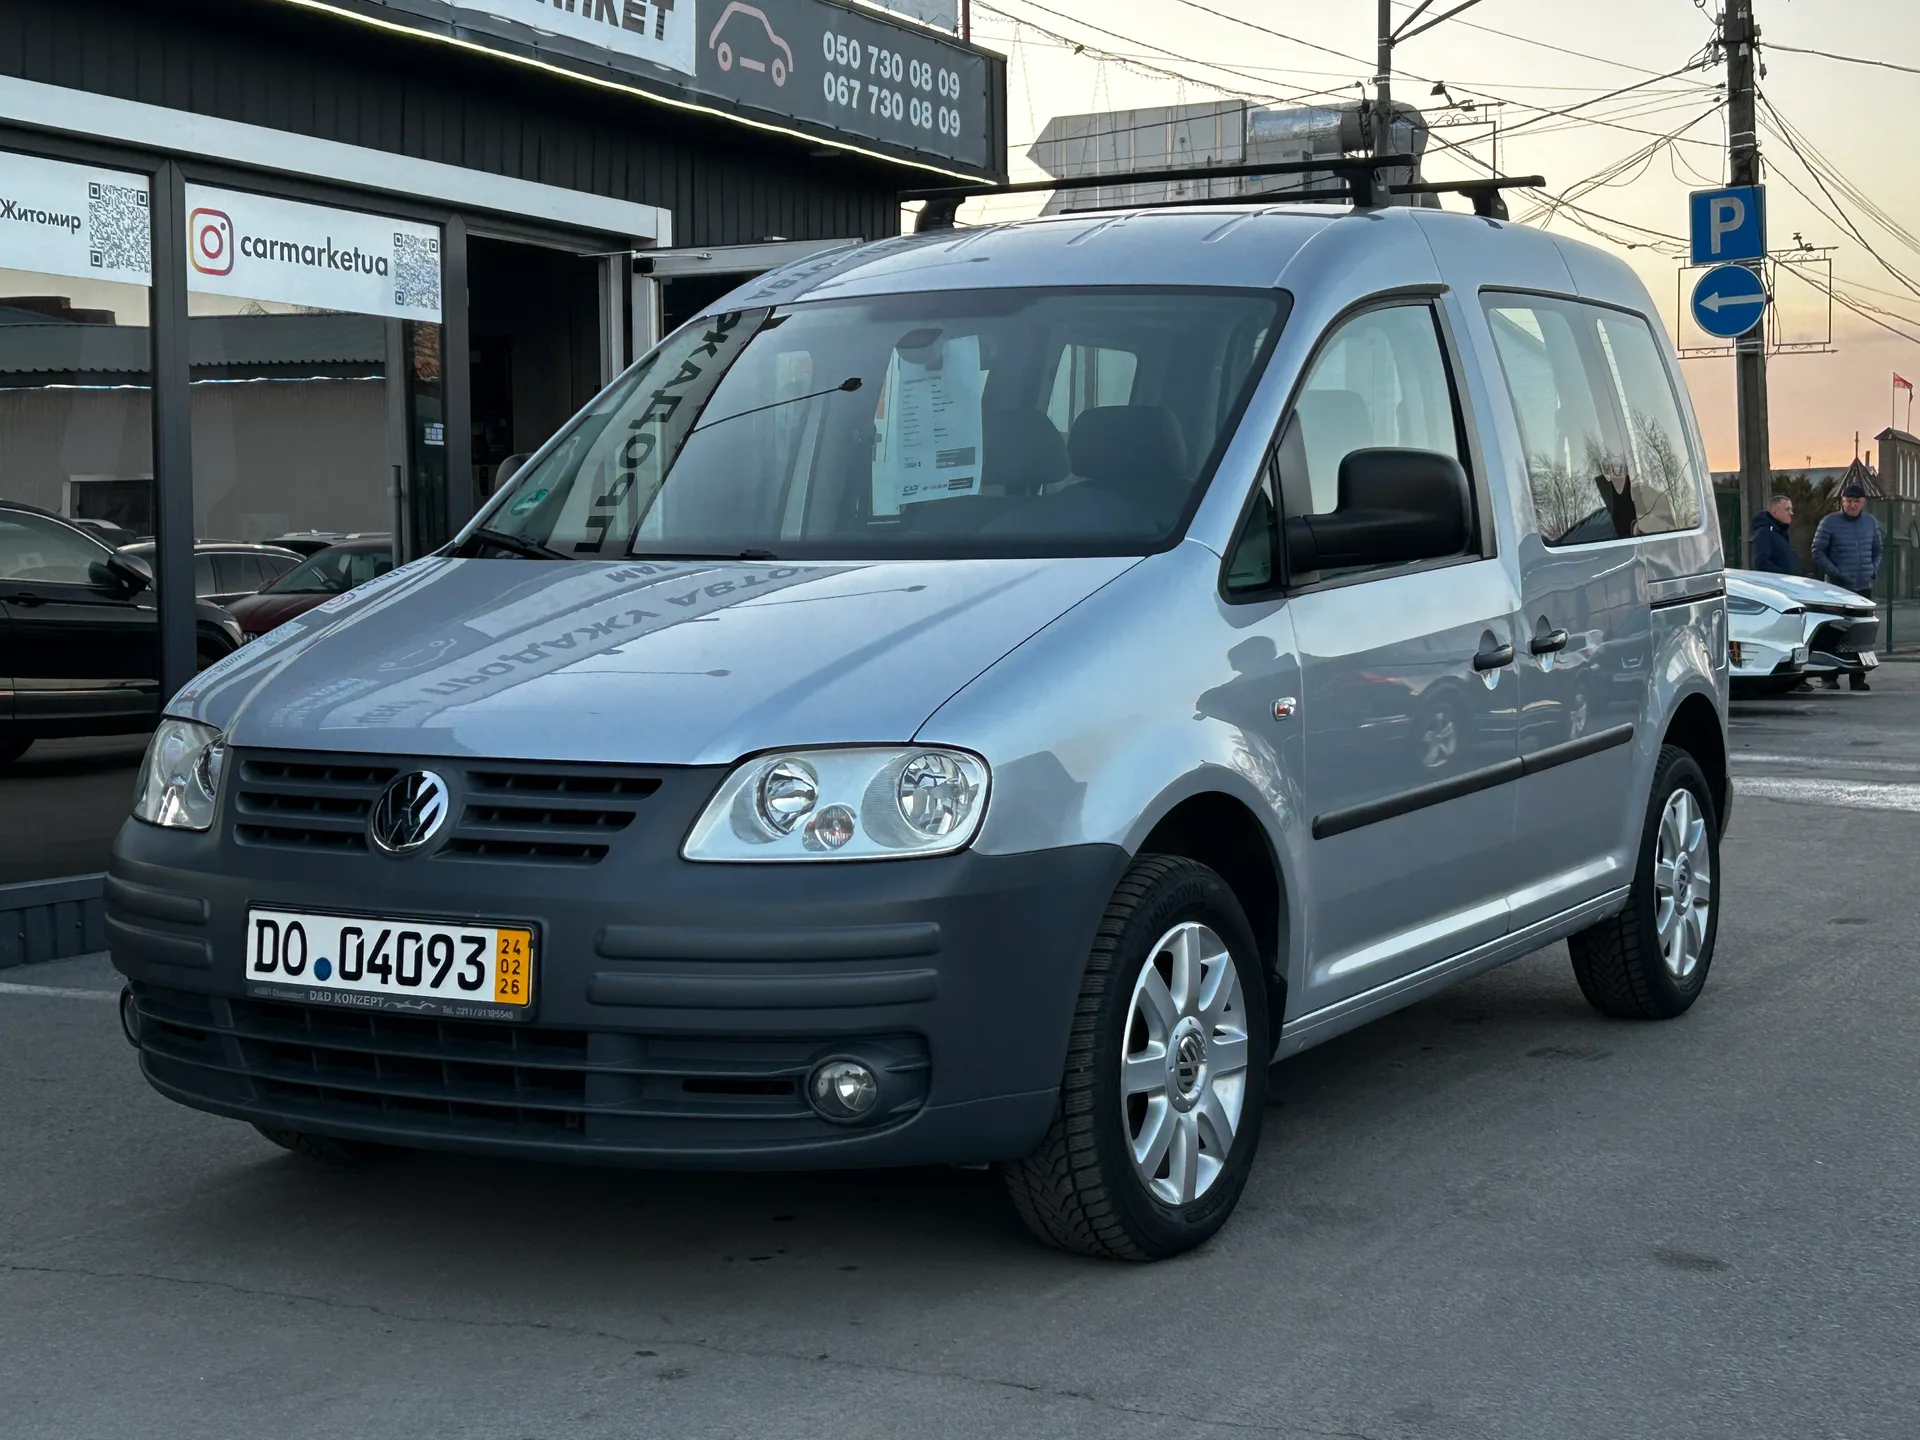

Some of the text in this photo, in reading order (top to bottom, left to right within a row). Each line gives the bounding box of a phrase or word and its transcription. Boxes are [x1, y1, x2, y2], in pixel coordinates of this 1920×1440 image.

[536, 0, 674, 41] KET
[823, 31, 961, 101] 050 730 08 09
[823, 71, 961, 138] 067 730 08 09
[0, 198, 81, 235] Житомир
[1710, 197, 1745, 254] P
[240, 236, 389, 277] carmarketua
[254, 919, 487, 991] DO 04093
[500, 958, 522, 976] 02
[501, 938, 522, 957] 24
[309, 990, 332, 1002] D&D
[334, 992, 385, 1009] KONZEPT
[499, 978, 520, 996] 26
